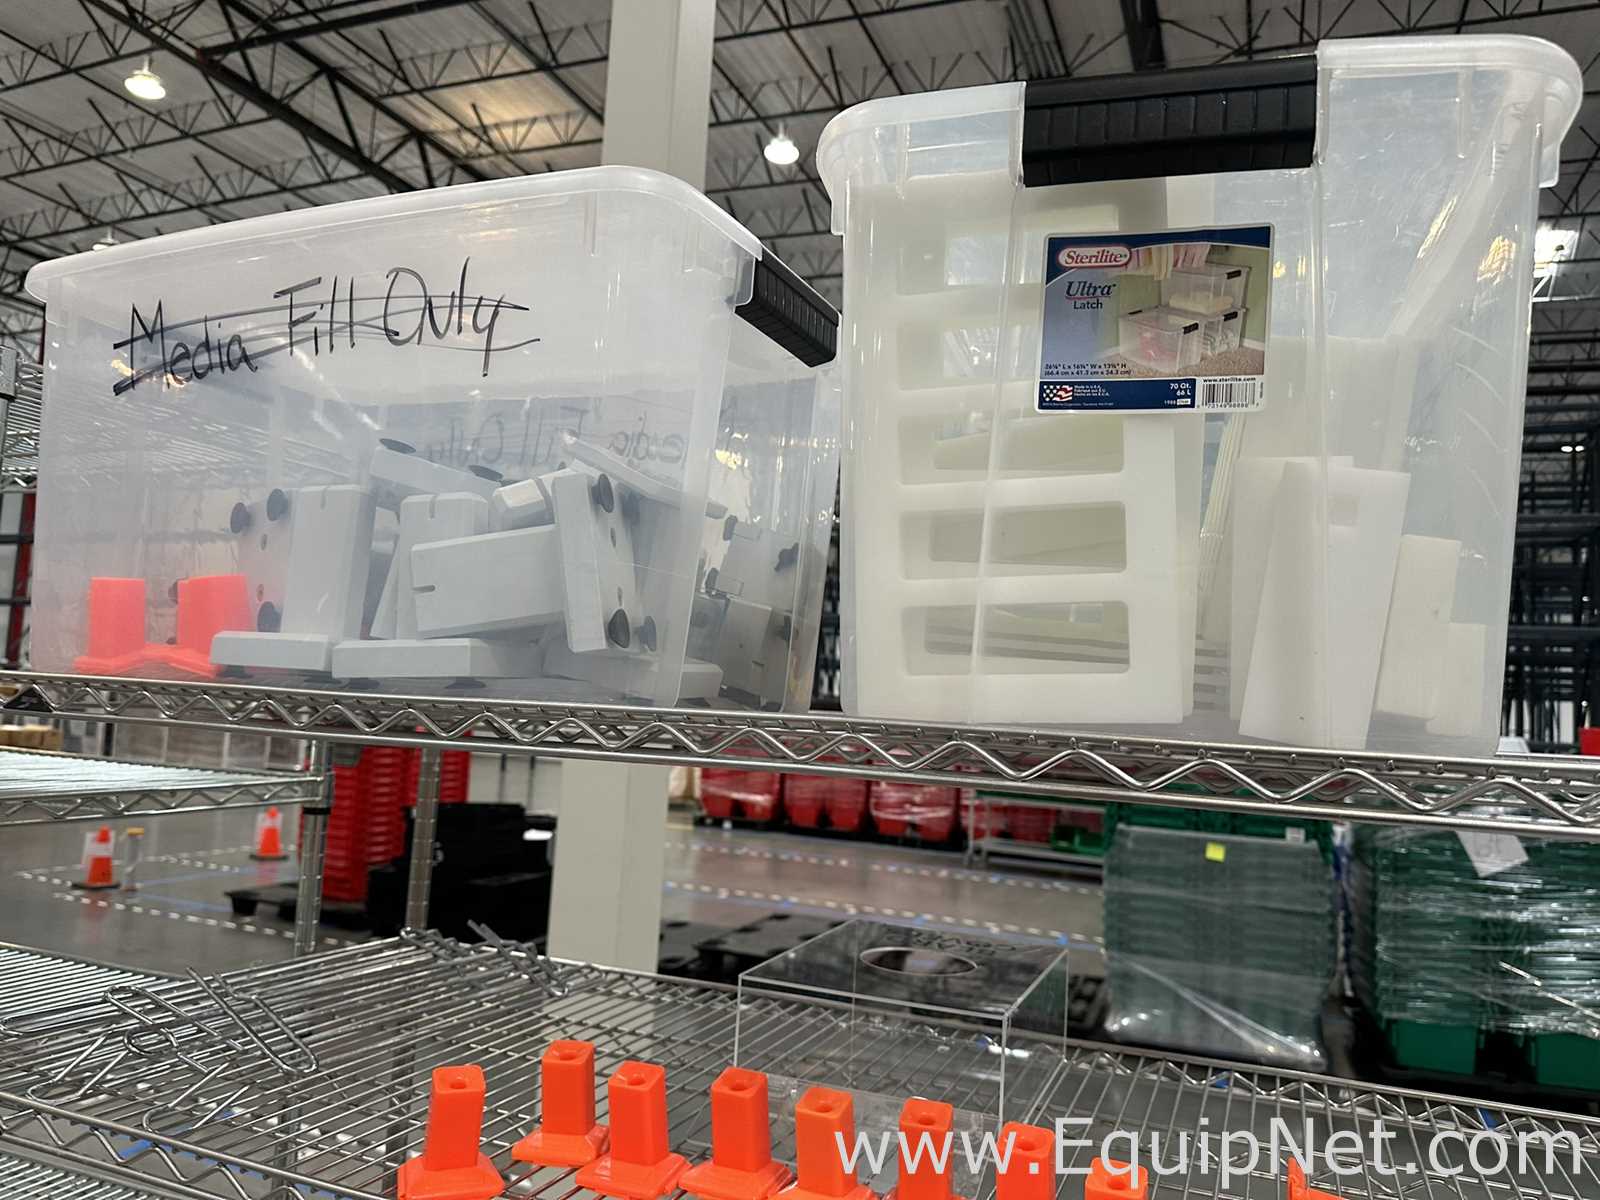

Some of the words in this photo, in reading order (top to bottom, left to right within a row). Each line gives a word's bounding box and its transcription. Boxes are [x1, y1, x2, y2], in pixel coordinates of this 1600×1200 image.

[1065, 249, 1121, 265] Sterilite
[1066, 281, 1113, 297] Ultra
[1073, 299, 1103, 310] Latch
[131, 299, 258, 390] Media
[273, 276, 355, 356] Fill
[385, 256, 505, 377] Only
